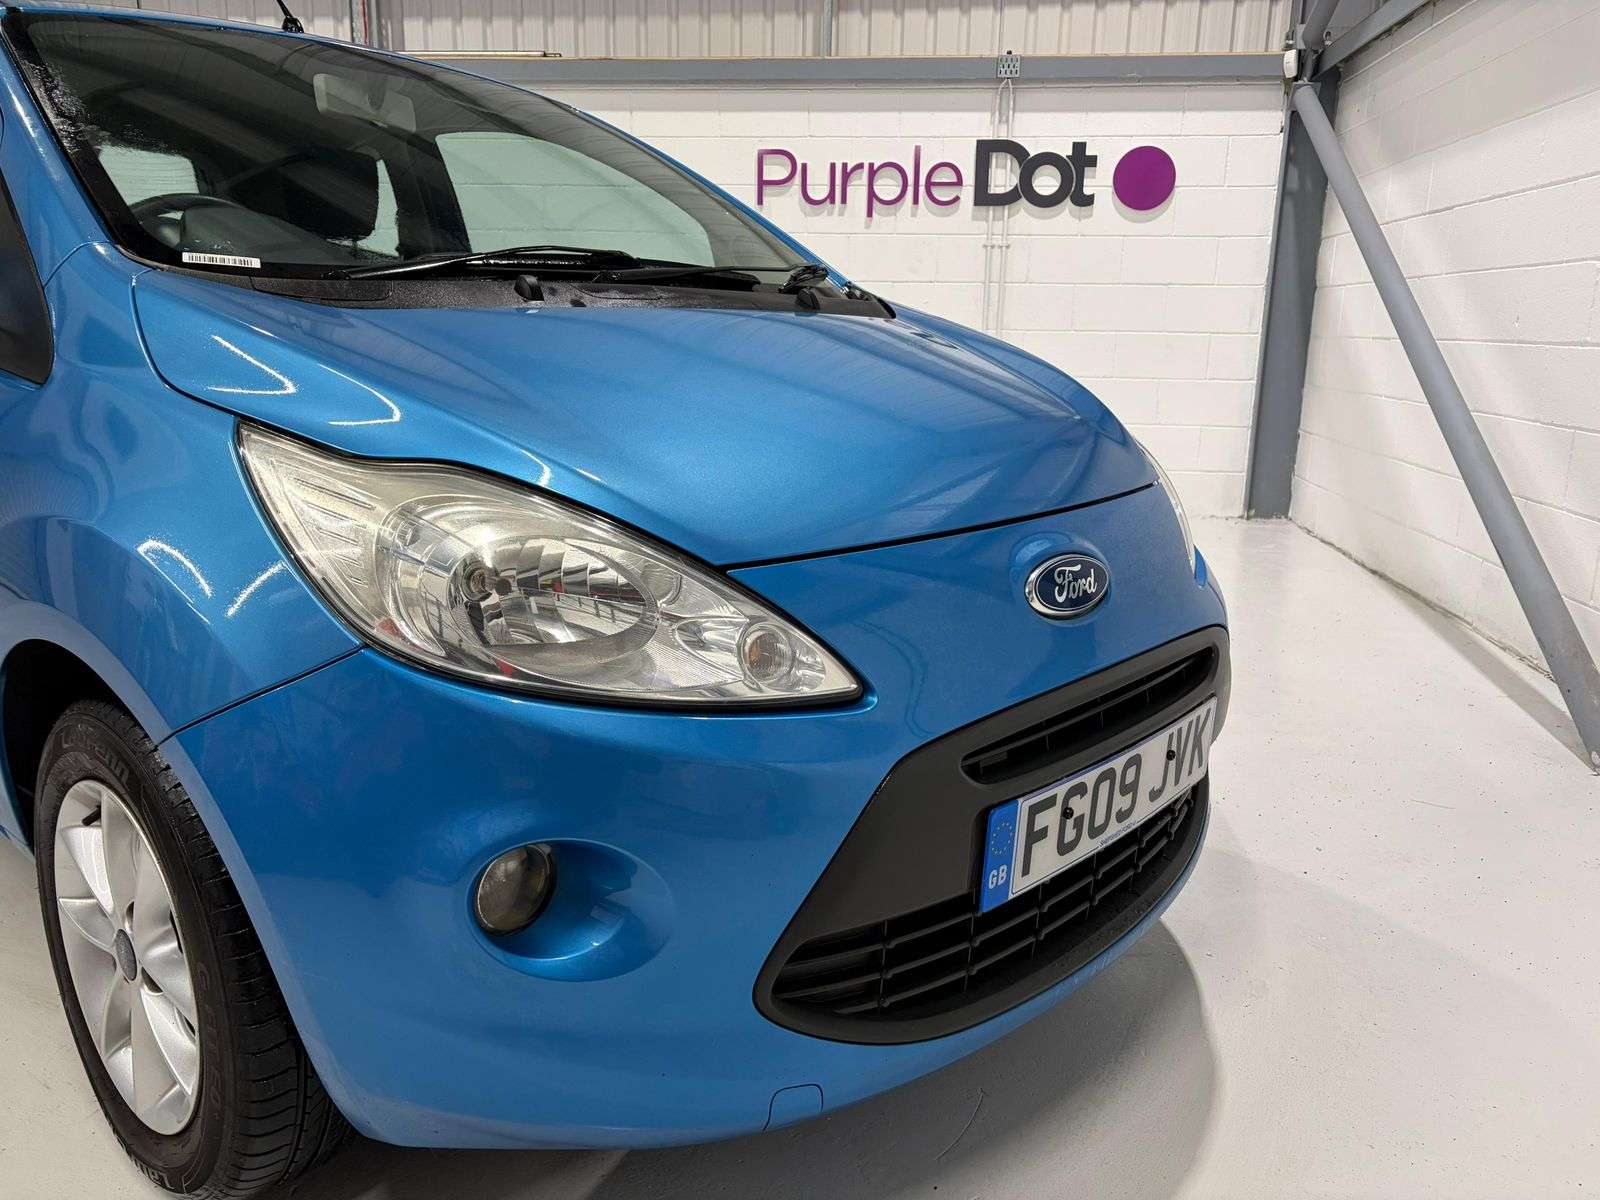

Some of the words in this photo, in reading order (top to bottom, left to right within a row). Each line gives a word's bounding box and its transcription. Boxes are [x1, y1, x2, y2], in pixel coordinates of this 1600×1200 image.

[757, 145, 964, 218] Purple
[973, 139, 1098, 208] Dot
[1054, 564, 1098, 603] Ford
[1021, 753, 1143, 878] FG09
[1148, 707, 1212, 803] JVK
[988, 864, 1008, 890] GB
